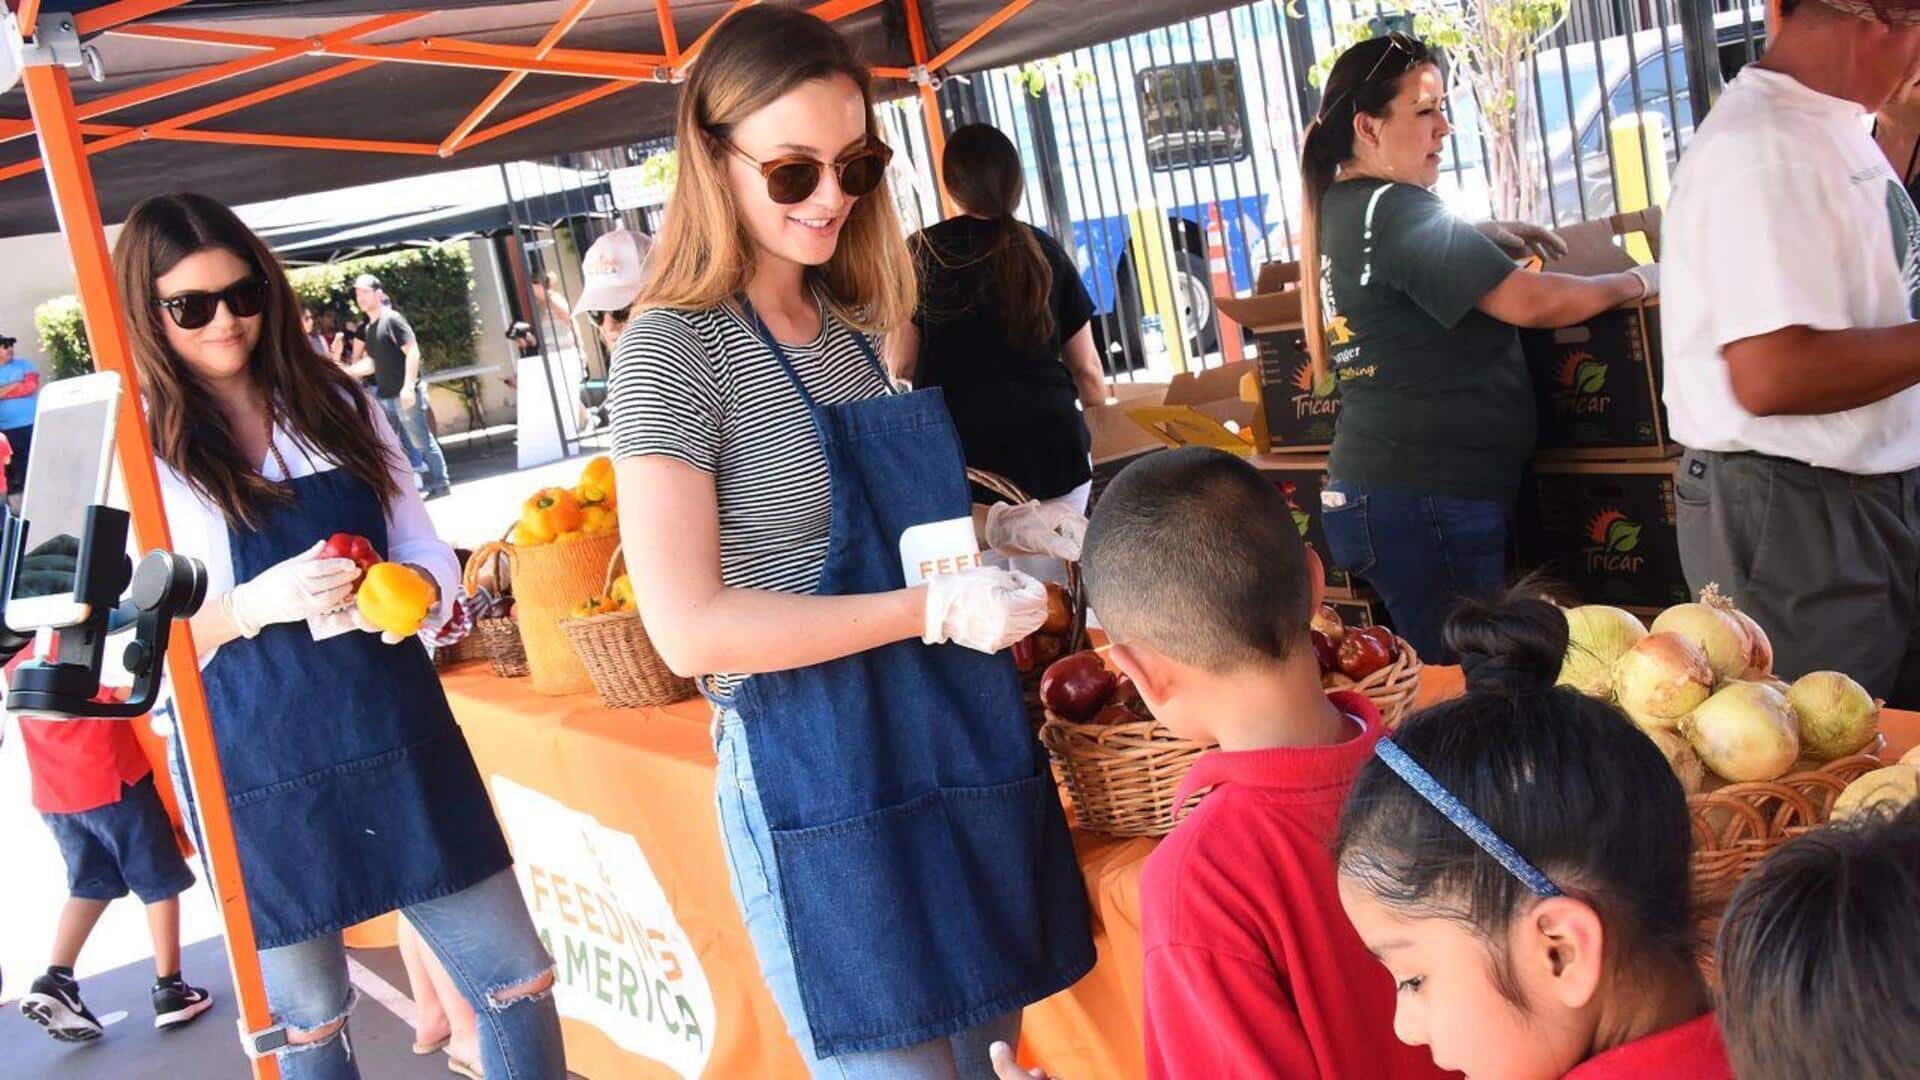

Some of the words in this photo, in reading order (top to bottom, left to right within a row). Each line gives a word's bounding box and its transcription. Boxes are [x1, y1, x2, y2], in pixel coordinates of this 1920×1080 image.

[1291, 393, 1341, 420] Tricar
[1554, 394, 1611, 417] Tricar
[1583, 547, 1644, 575] Tricar
